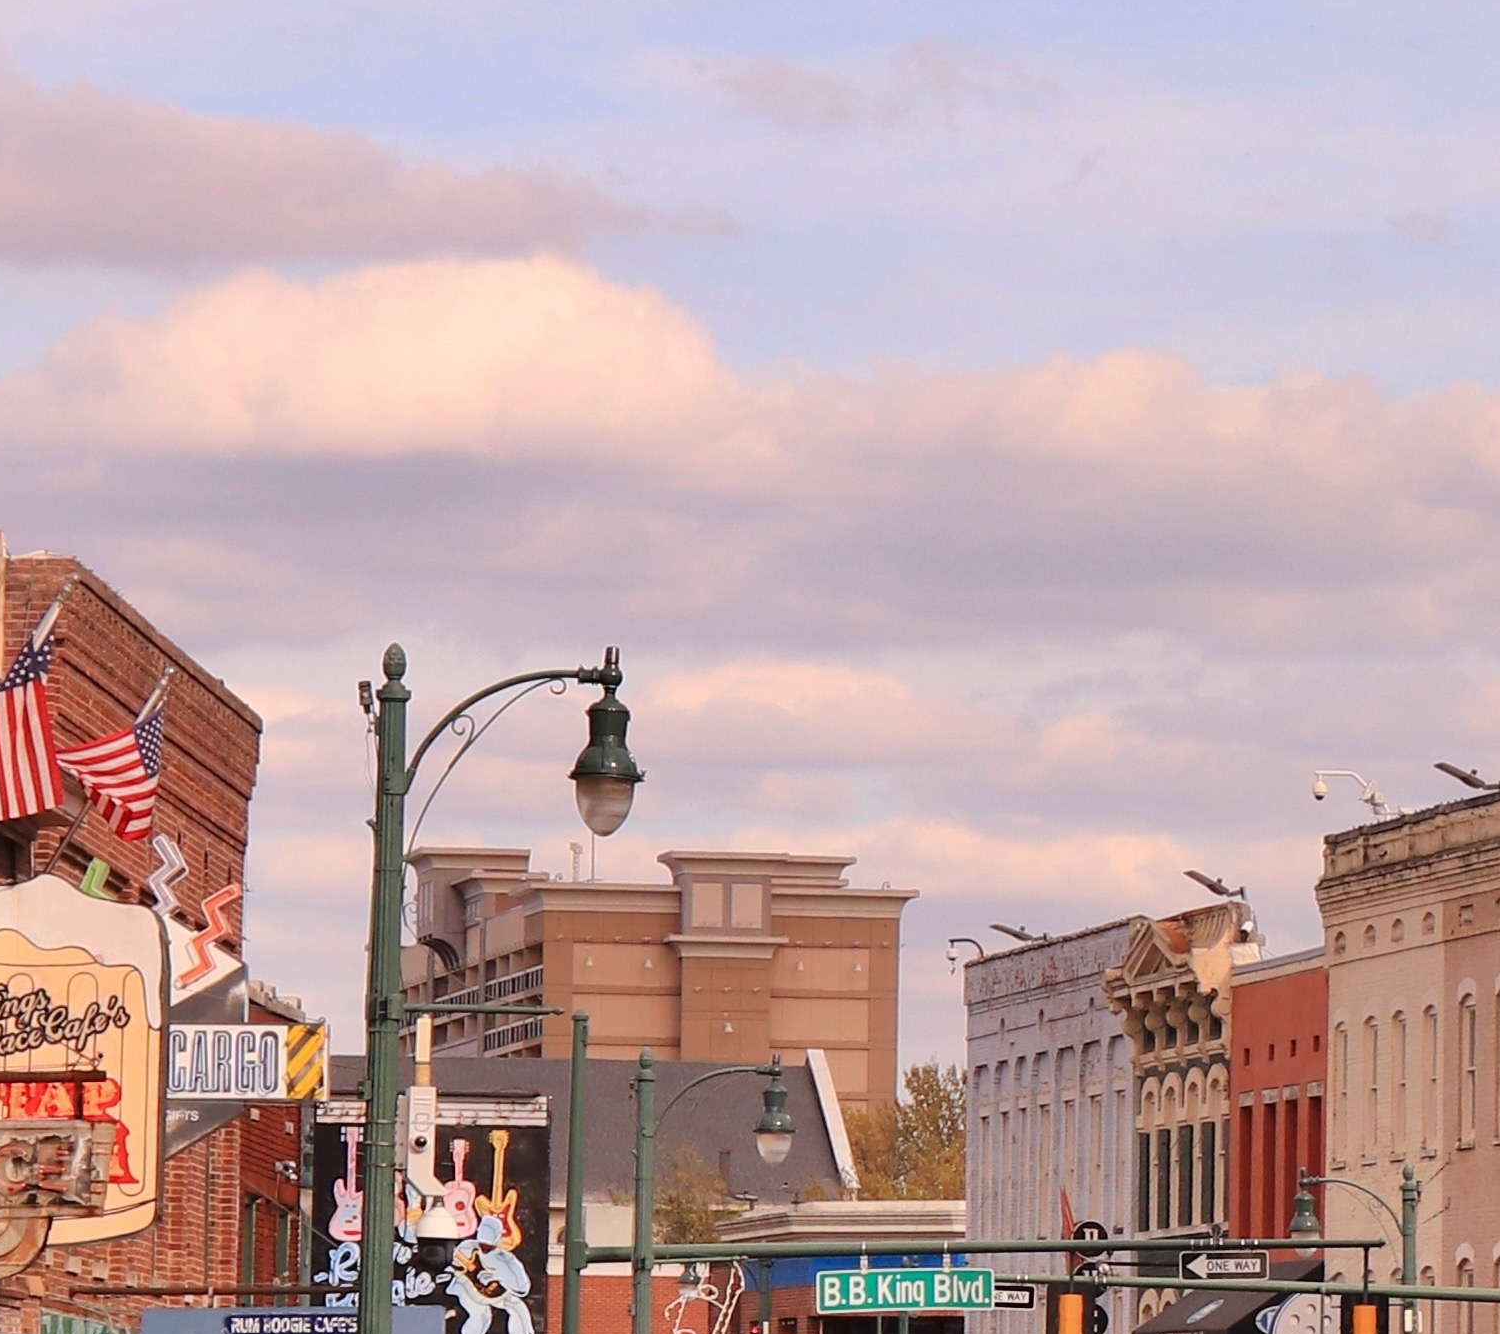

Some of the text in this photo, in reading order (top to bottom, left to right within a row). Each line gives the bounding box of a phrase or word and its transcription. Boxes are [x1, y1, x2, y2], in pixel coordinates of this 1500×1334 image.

[168, 1029, 279, 1094] CARGO
[1206, 1259, 1258, 1271] ONE WAY
[823, 1275, 991, 1310] B.B. King Blvd.
[994, 1290, 1027, 1302] NE WAY
[231, 1317, 358, 1334] RUM BOOGIE CAFE'S
